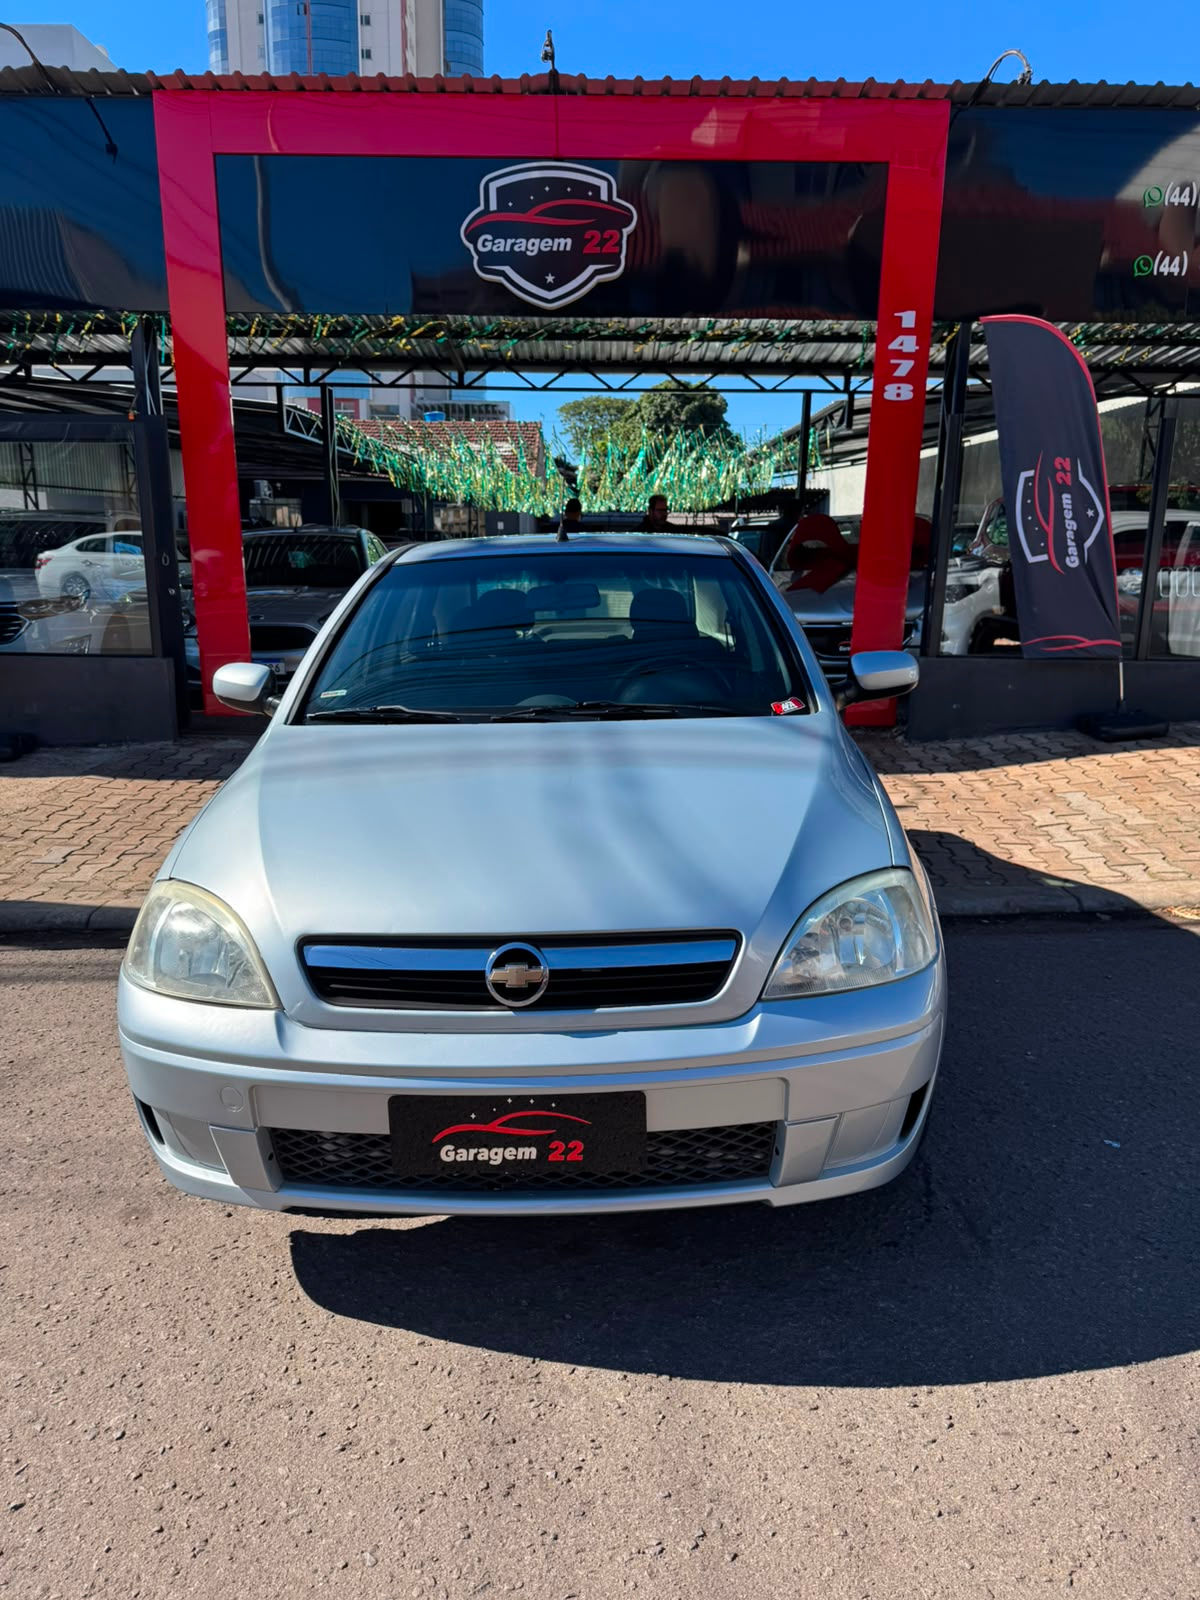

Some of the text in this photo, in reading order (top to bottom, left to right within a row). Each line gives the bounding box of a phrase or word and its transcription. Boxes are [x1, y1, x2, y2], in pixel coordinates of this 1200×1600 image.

[1164, 182, 1197, 206] (44)
[477, 229, 620, 256] Garagem 22
[1153, 250, 1188, 276] (44)
[883, 310, 920, 401] 1478
[1054, 456, 1080, 568] Garagem 22
[439, 1140, 584, 1165] Garagem 22
